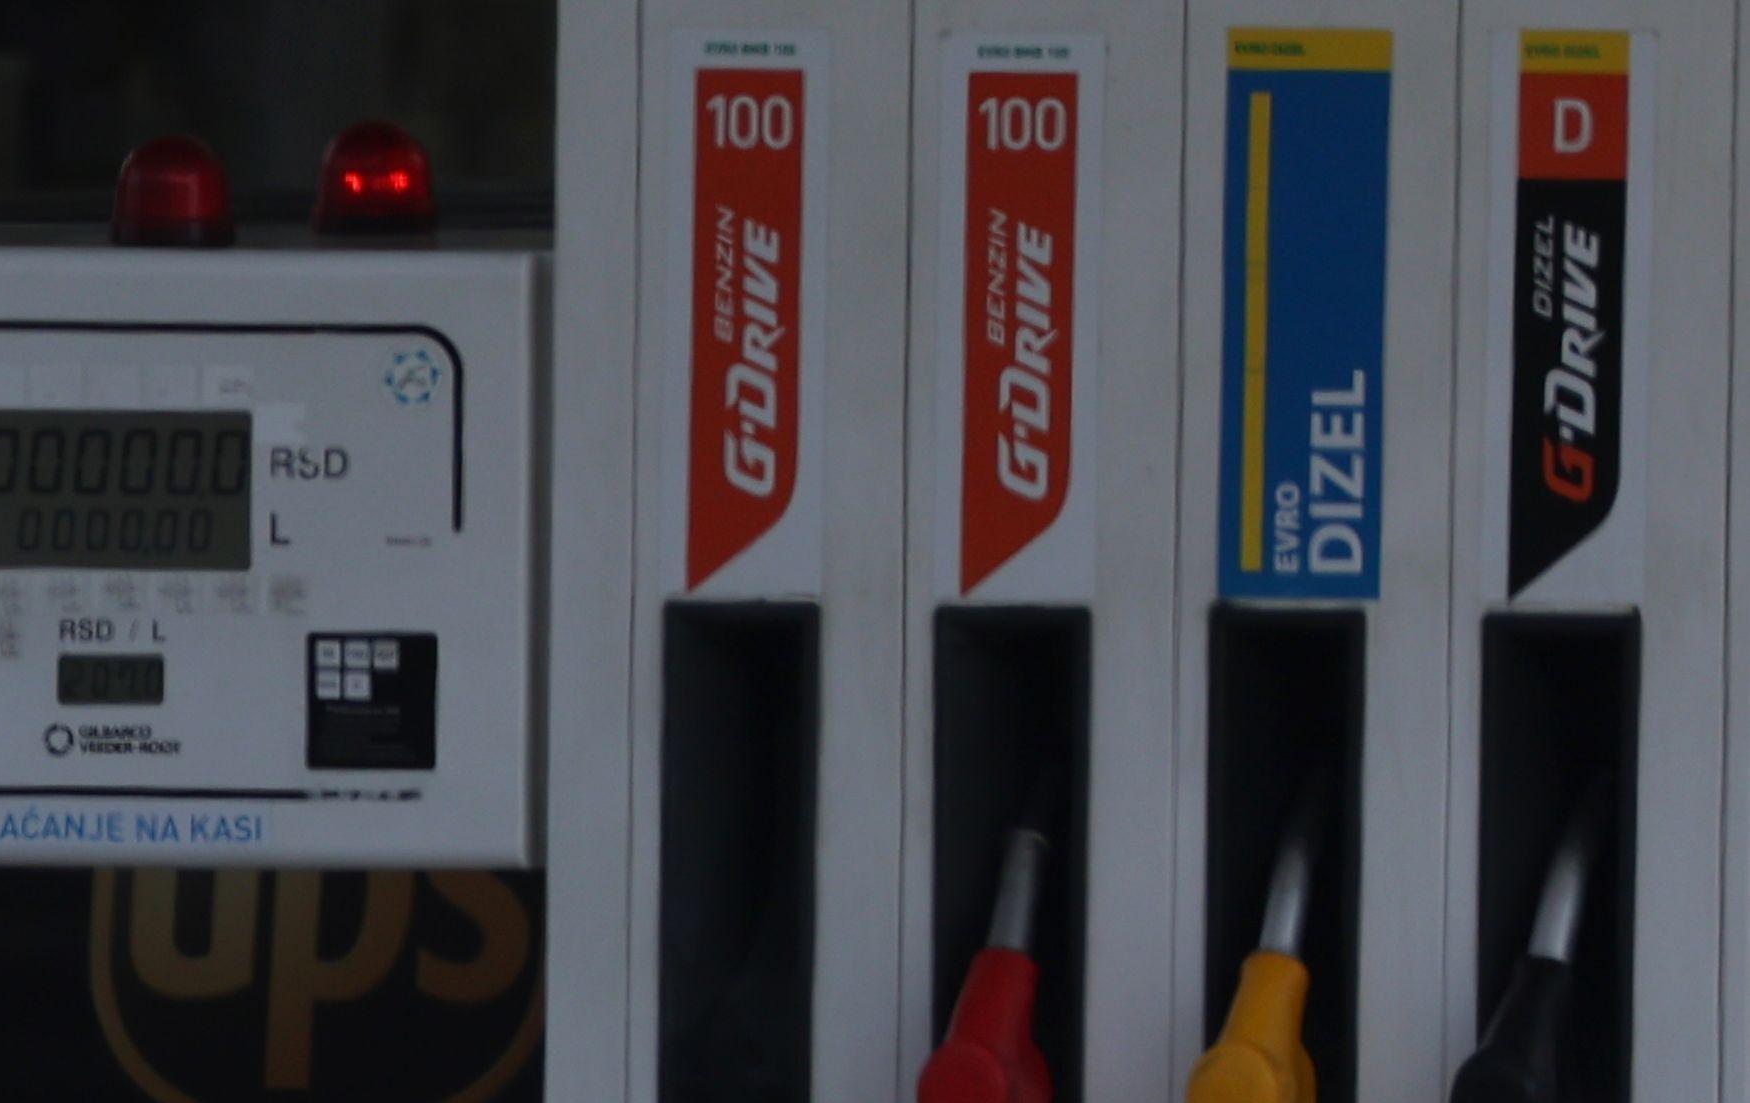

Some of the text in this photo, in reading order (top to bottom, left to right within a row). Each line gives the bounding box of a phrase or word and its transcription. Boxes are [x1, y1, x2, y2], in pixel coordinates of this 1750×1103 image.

[705, 95, 794, 150] 100
[978, 97, 1067, 152] 100
[1552, 97, 1593, 154] D
[714, 203, 736, 343] BENZIN
[986, 208, 1009, 347] BENZIN
[1531, 214, 1554, 320] DIZEL
[269, 446, 348, 480] RSD
[1307, 368, 1366, 577] DIZEL
[269, 511, 292, 547] L
[1274, 480, 1300, 574] EVRO
[58, 618, 115, 644] RSD
[151, 620, 166, 643] L
[136, 816, 180, 843] NA
[190, 816, 264, 843] KASI
[128, 868, 530, 1091] ups
